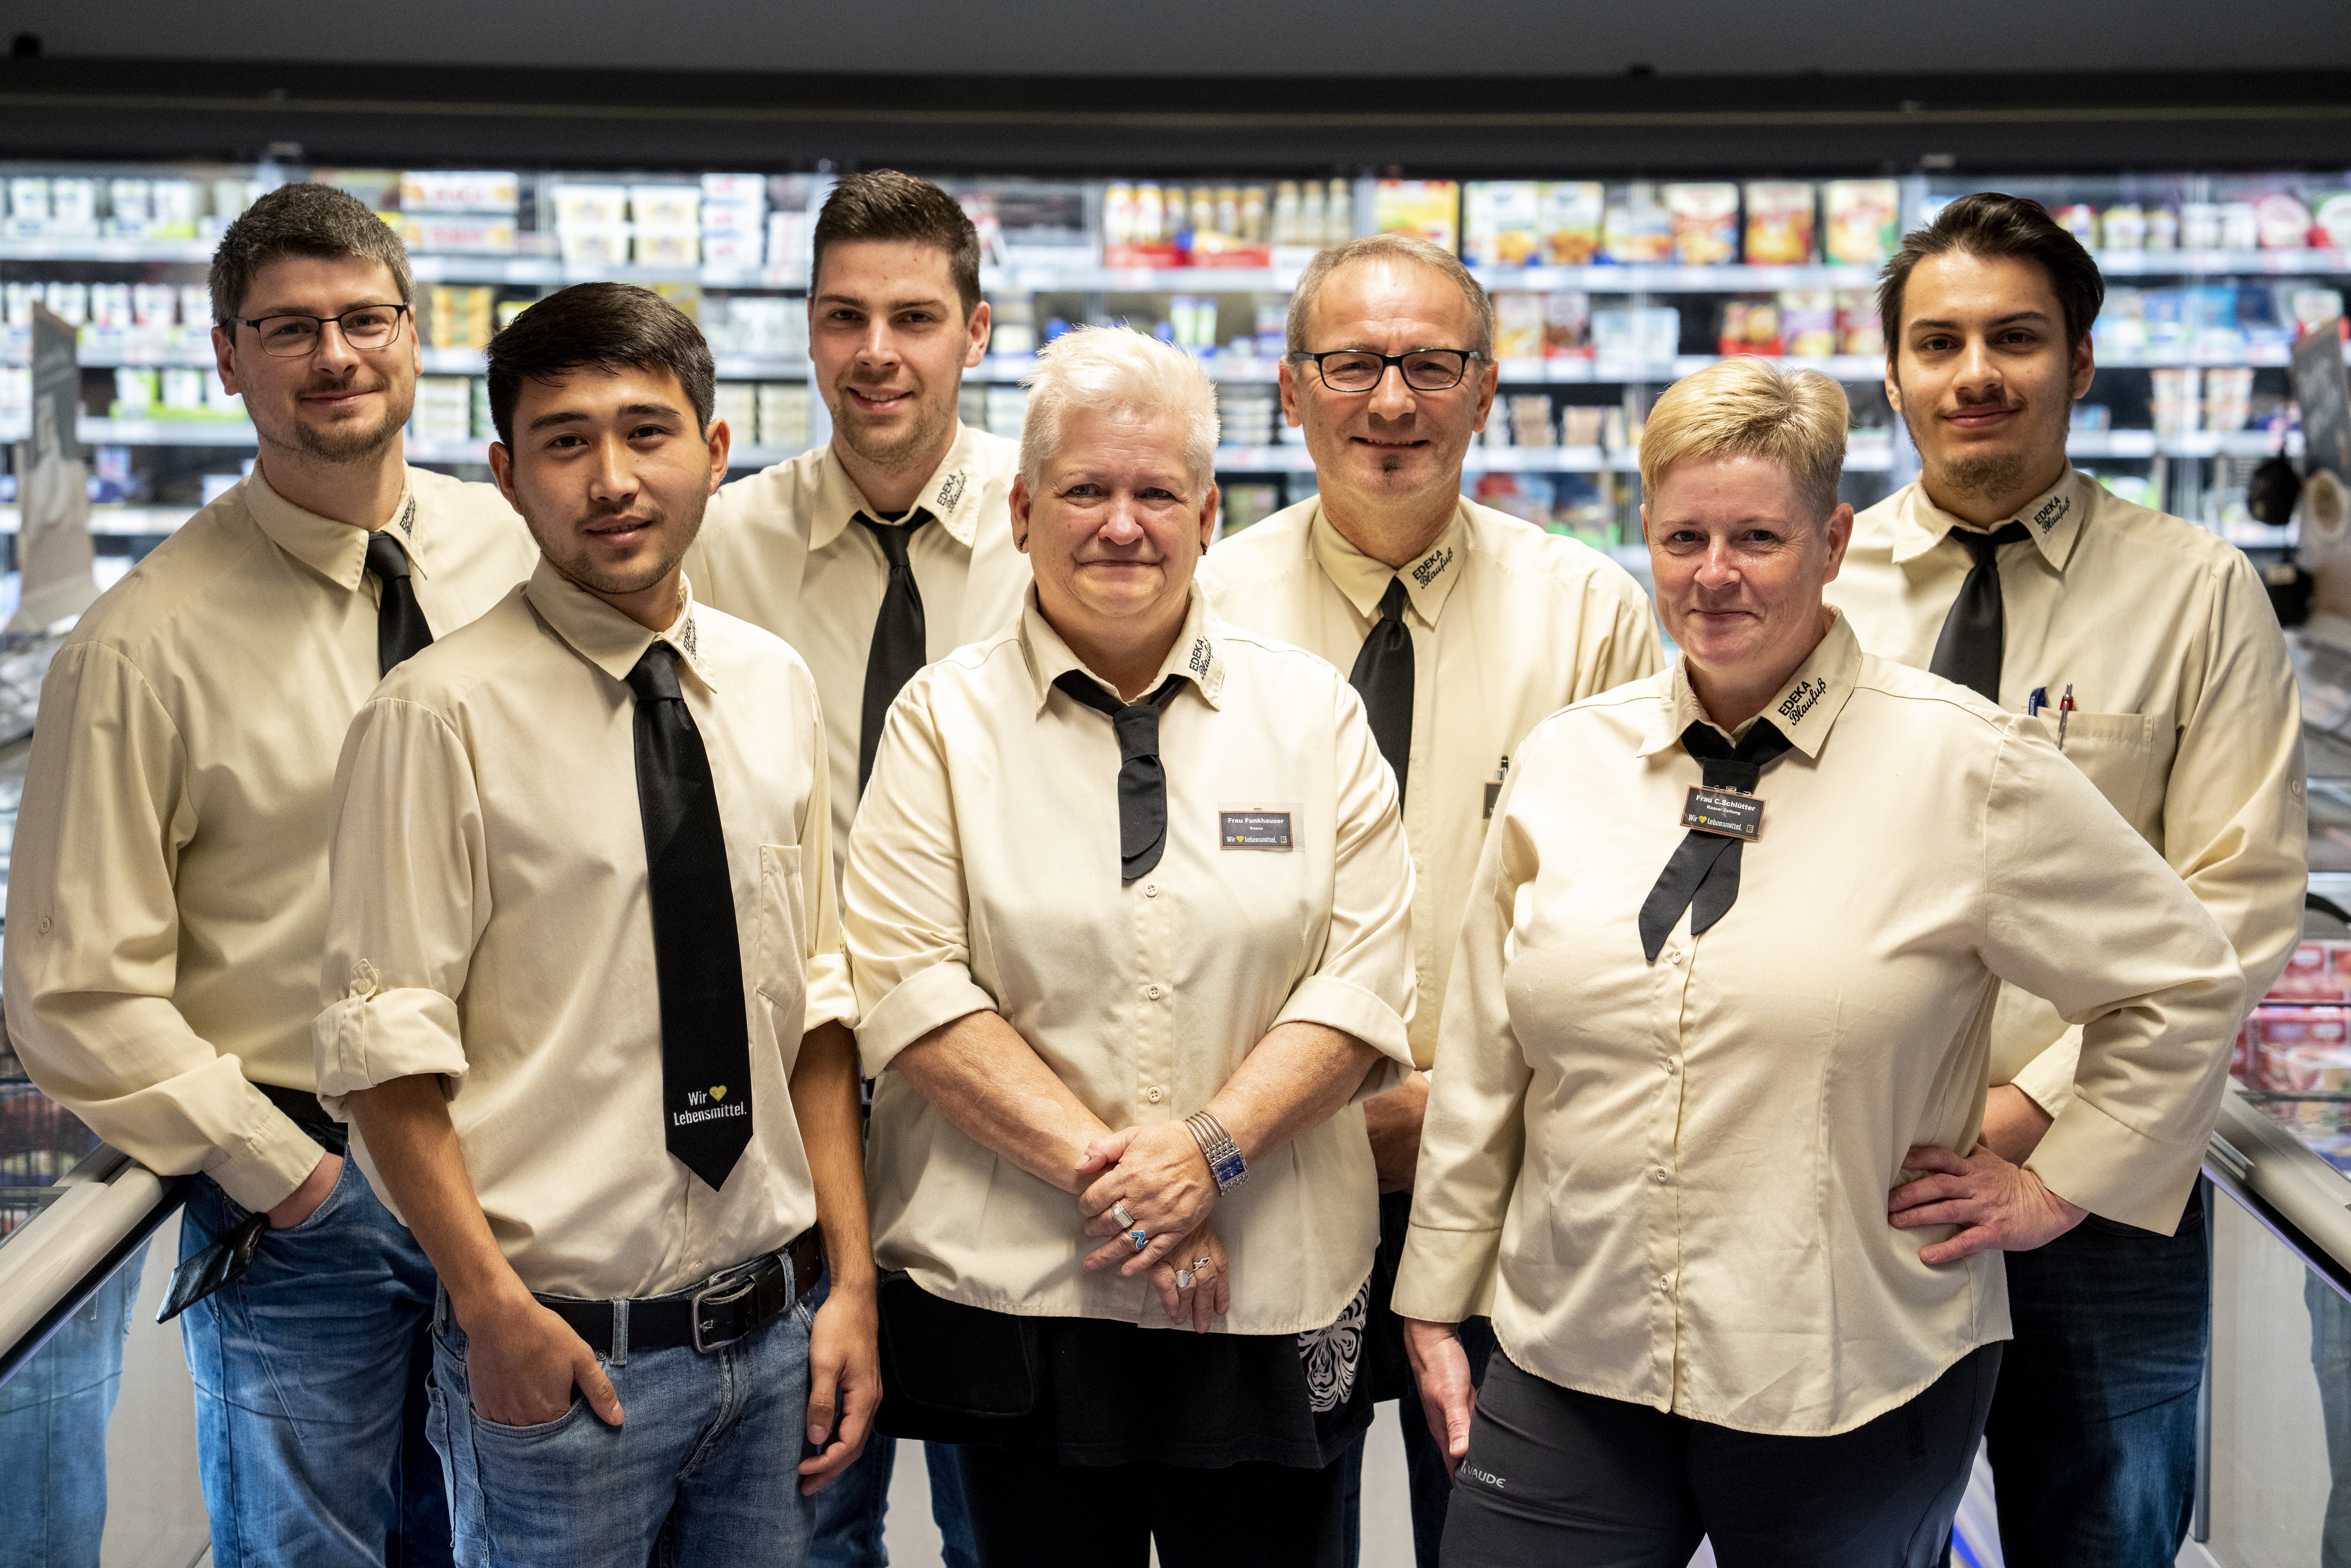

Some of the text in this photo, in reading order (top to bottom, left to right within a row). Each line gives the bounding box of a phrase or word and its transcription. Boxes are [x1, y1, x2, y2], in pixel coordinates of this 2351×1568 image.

[937, 474, 956, 506] EDEKA
[2034, 496, 2061, 525] EDEKA
[1412, 550, 1442, 581] EDEKA
[684, 618, 692, 652] EDEKA
[1189, 638, 1204, 672] EDEKA
[1778, 681, 1811, 717] EDEKA
[1789, 678, 1826, 725] Blaufuß
[1696, 795, 1712, 803] Frau
[1707, 818, 1742, 831] Lebensmittel.
[688, 1091, 707, 1106] Wir
[673, 1102, 747, 1126] Lebensmittel.
[1468, 1466, 1506, 1489] VAUDE
